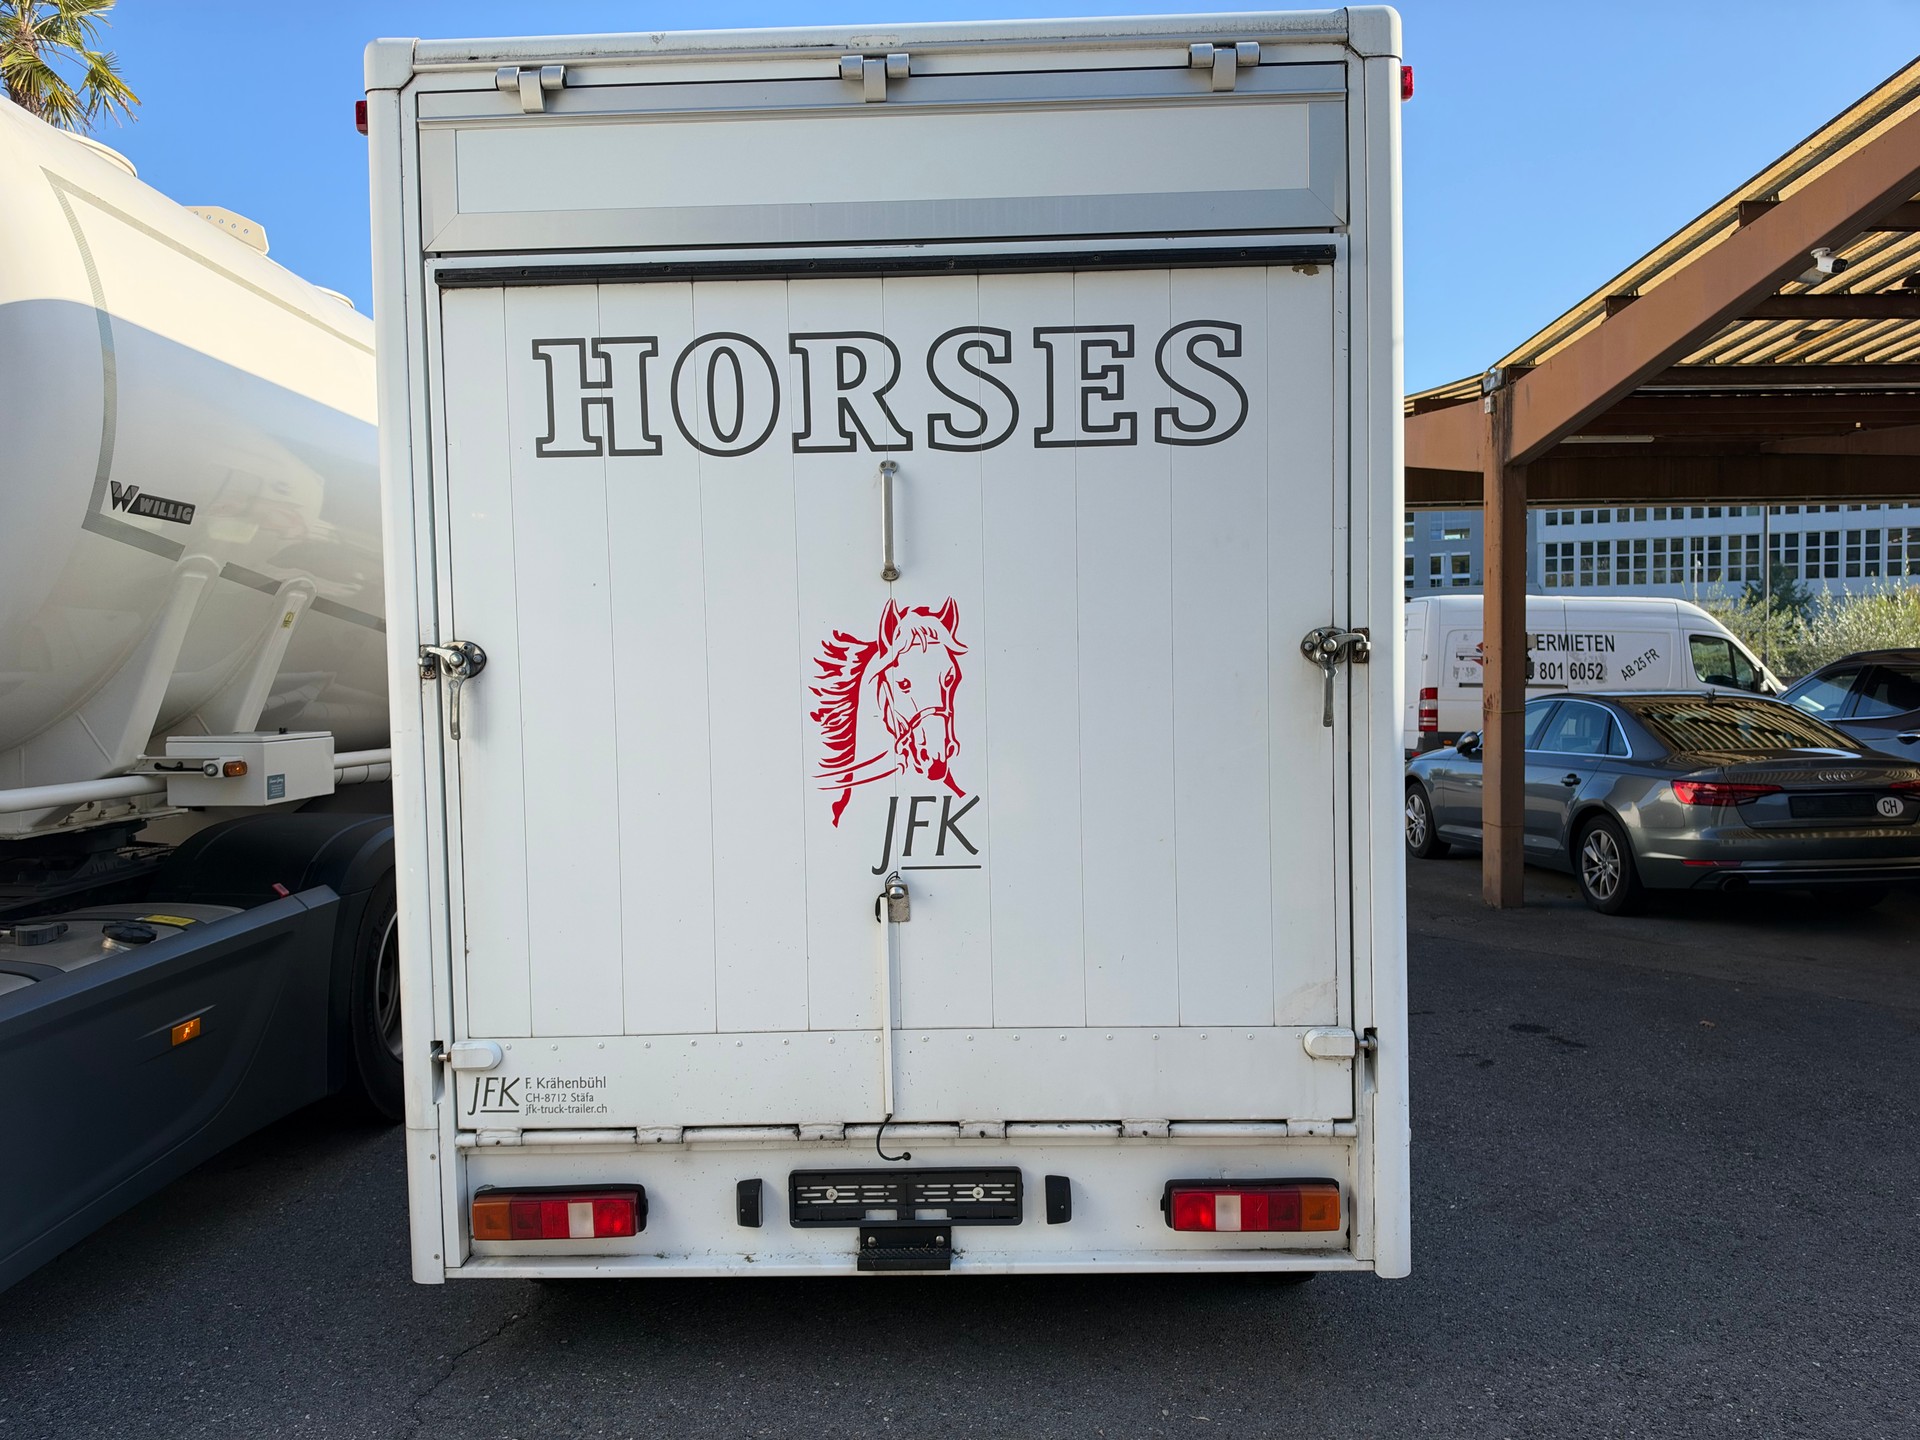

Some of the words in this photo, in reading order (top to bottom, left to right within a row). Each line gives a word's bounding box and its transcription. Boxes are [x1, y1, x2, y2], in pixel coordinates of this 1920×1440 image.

[531, 319, 1249, 458] HORSES
[139, 496, 194, 523] WILLIG
[1532, 633, 1616, 652] ERMIETEN
[1539, 662, 1564, 680] 801
[1569, 662, 1604, 681] 6052
[1620, 664, 1636, 681] AB
[1633, 656, 1648, 671] 25
[1643, 648, 1660, 664] FR
[1882, 799, 1898, 814] CH
[871, 795, 981, 875] JFK
[525, 1077, 532, 1089] F.
[536, 1076, 607, 1089] Krähenbühl
[467, 1076, 520, 1116] JFK
[525, 1092, 567, 1103] CH-8712
[570, 1092, 594, 1103] Stäfa
[525, 1103, 608, 1116] jfk-truck-trailer.ch
